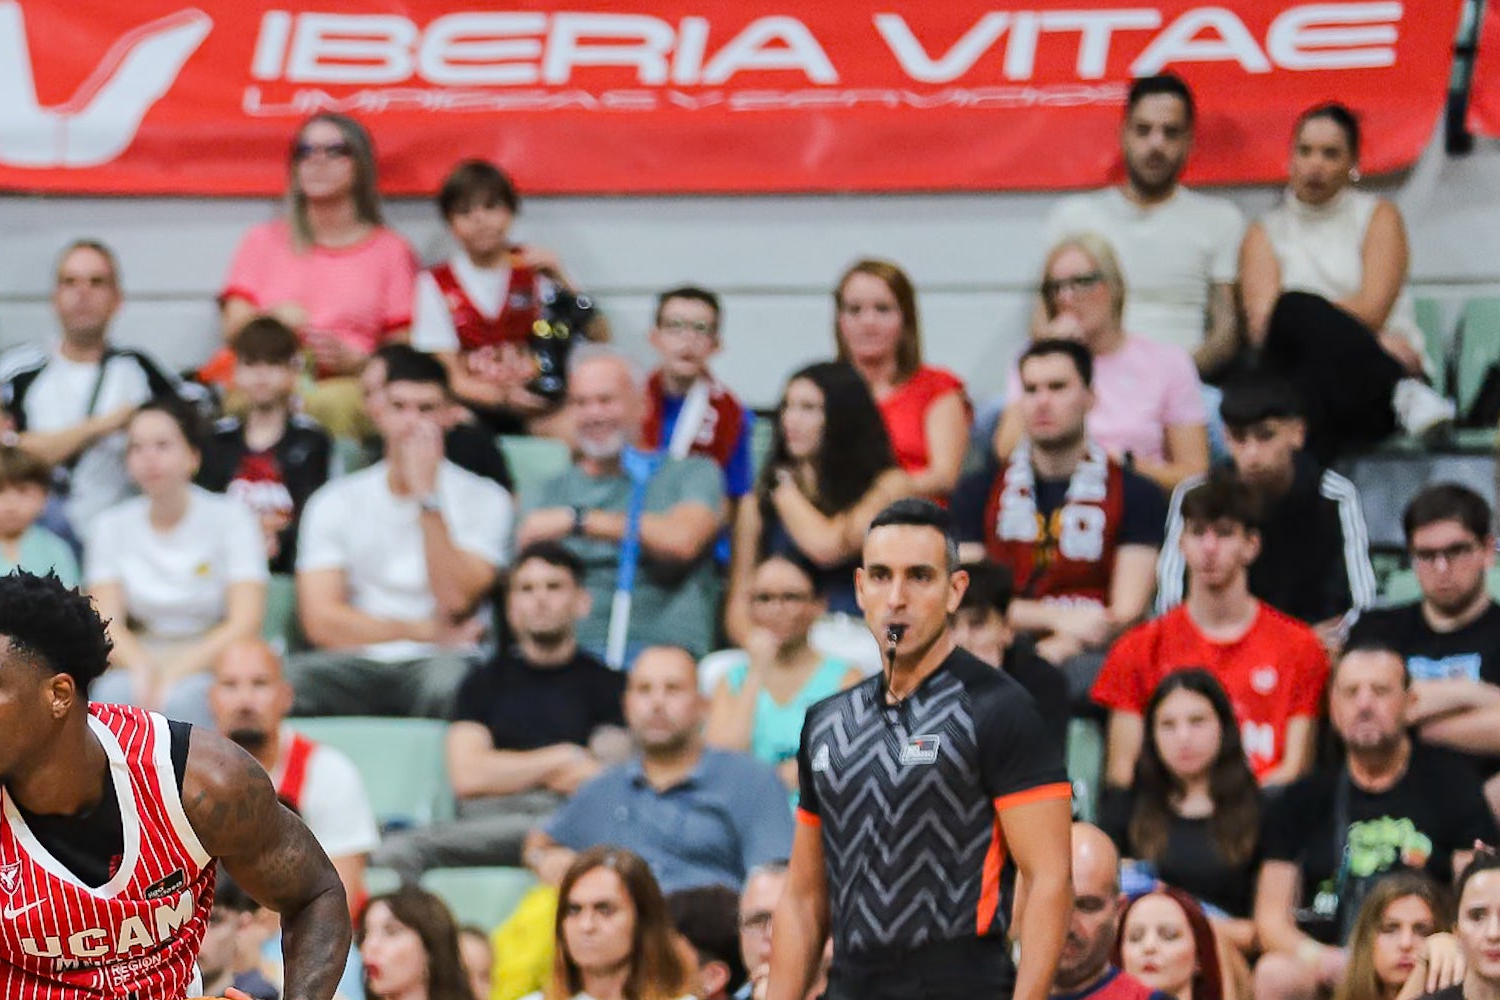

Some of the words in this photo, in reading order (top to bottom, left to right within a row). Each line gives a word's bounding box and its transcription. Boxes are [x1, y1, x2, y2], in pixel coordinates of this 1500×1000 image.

[251, 9, 840, 87] IBERIA
[874, 1, 1404, 82] VITAE
[21, 889, 193, 958] UCAM
